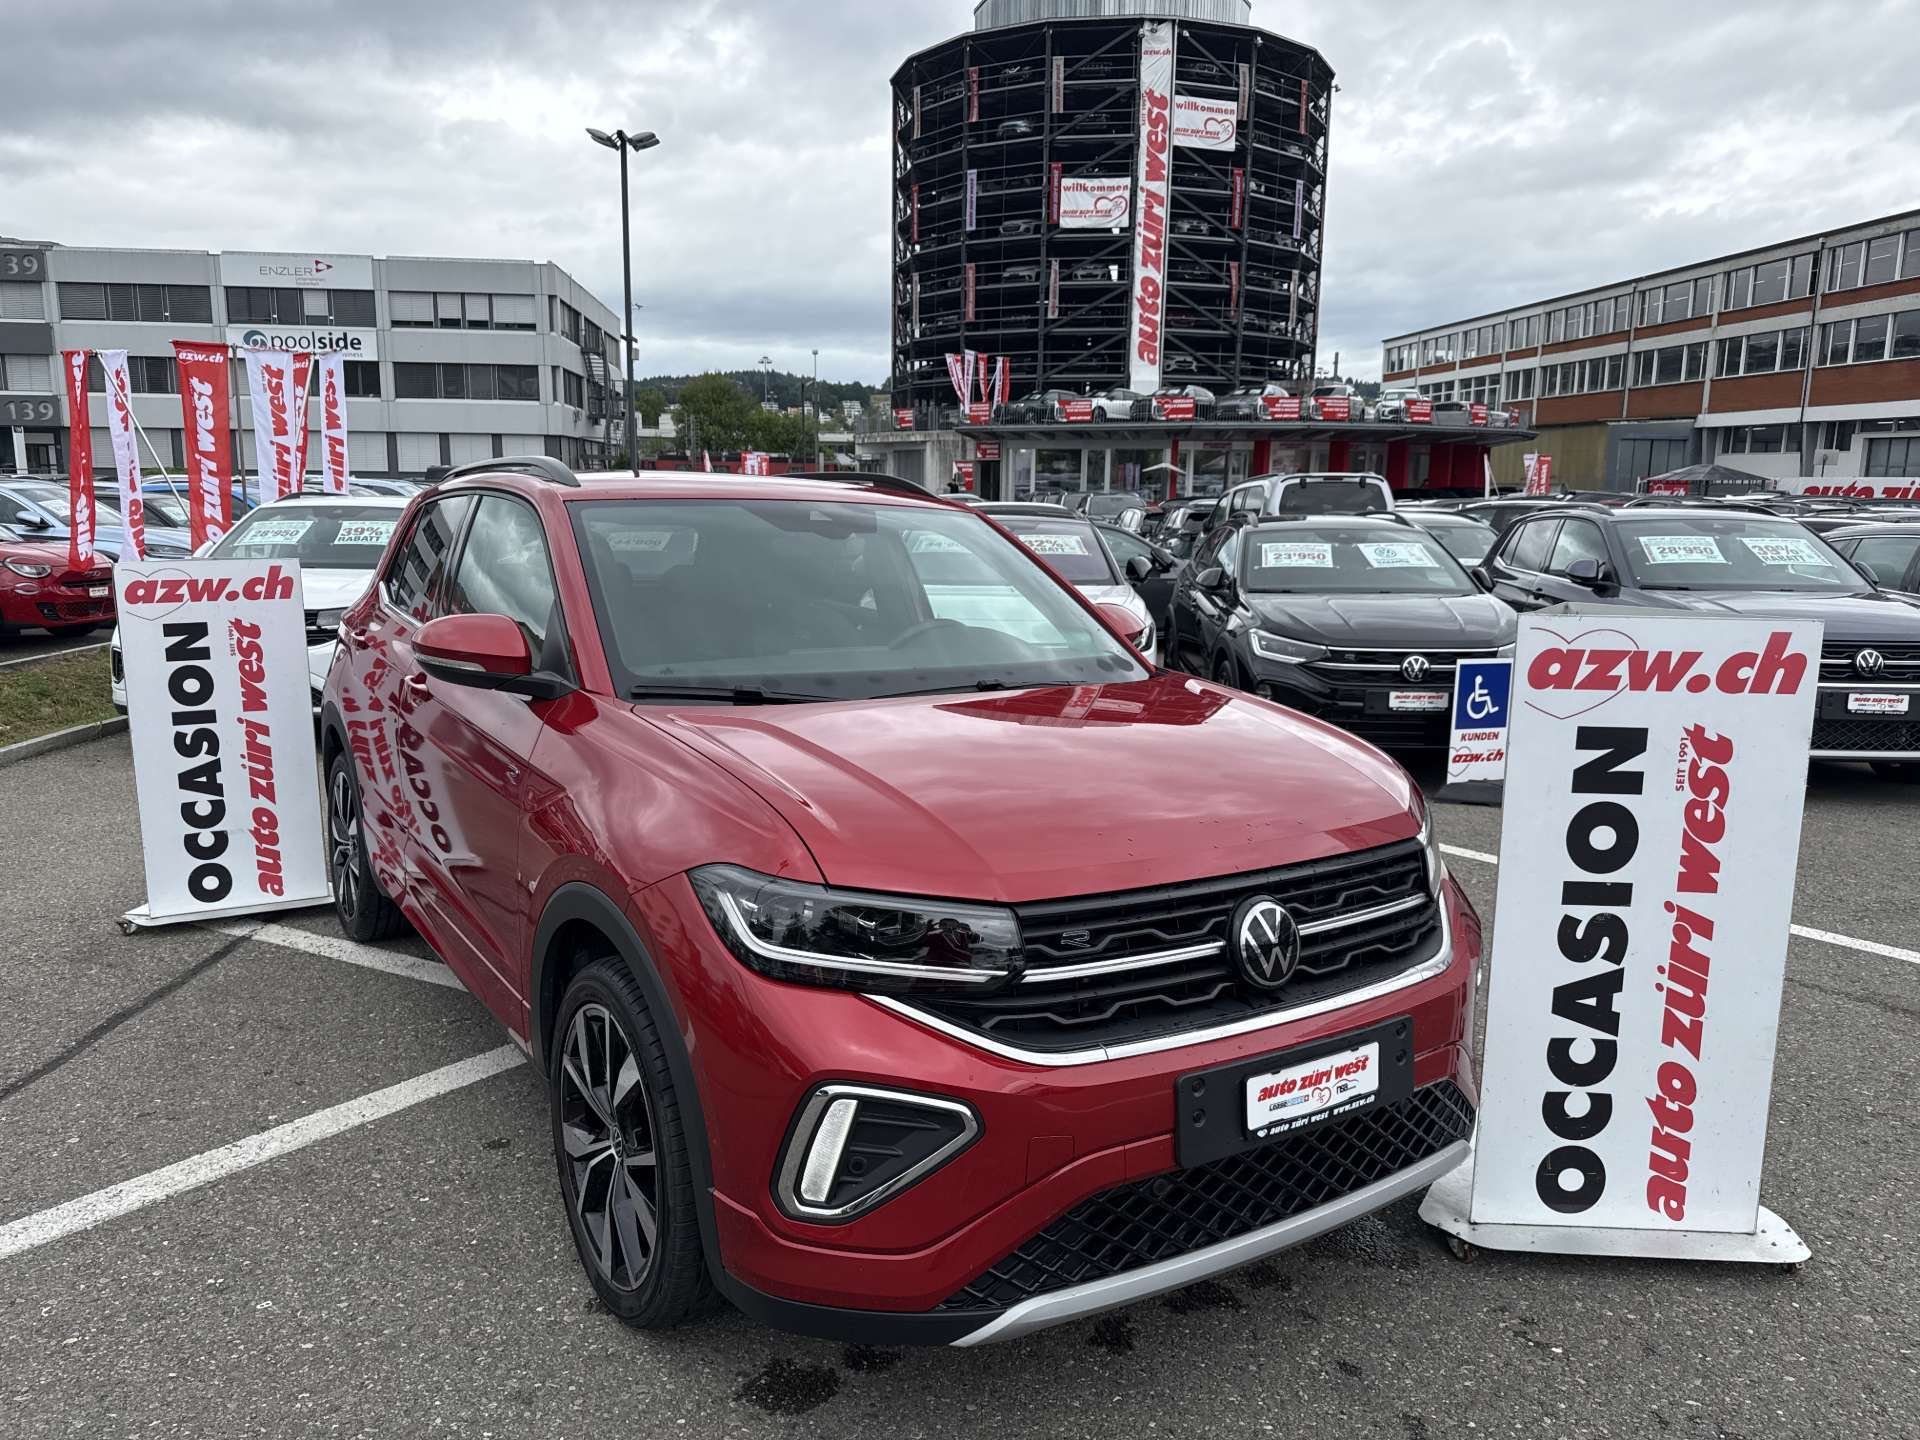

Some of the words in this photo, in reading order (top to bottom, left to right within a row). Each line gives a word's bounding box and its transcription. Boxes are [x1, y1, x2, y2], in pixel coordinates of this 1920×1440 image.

[1143, 48, 1171, 56] azw.ch
[1175, 101, 1236, 115] willkommen
[1144, 87, 1169, 181] west
[1063, 183, 1129, 192] willkommen
[1136, 186, 1165, 275] züri
[4, 254, 38, 275] 39
[259, 265, 313, 276] ENZLER
[271, 331, 362, 351] poolside
[1135, 276, 1161, 366] auto
[178, 350, 224, 364] azw.ch
[4, 401, 53, 420] 139
[189, 376, 216, 452] west
[259, 363, 289, 437] west
[194, 453, 224, 523] züri
[340, 526, 383, 537] 39%
[1656, 545, 1715, 555] 28'950
[1273, 552, 1326, 561] 23'950
[125, 565, 294, 605] azw.ch
[228, 617, 269, 712] west
[1527, 631, 1808, 695] azw.ch
[1452, 749, 1505, 764] azw.ch
[1460, 731, 1500, 742] KUNDEN
[1678, 737, 1690, 764] 1991
[162, 621, 233, 903] OCCASION
[236, 716, 277, 804] züri
[1675, 768, 1686, 792] SEIT
[1676, 723, 1734, 894] west
[247, 806, 285, 897] auto
[1535, 725, 1649, 1214] OCCASION
[1654, 900, 1715, 1062] züri
[1257, 1079, 1298, 1103] auto
[1298, 1065, 1334, 1091] züri
[1335, 1055, 1370, 1080] west
[1269, 1123, 1290, 1135] auto
[1290, 1115, 1310, 1129] züri
[1310, 1110, 1329, 1123] west
[1645, 1061, 1698, 1222] auto
